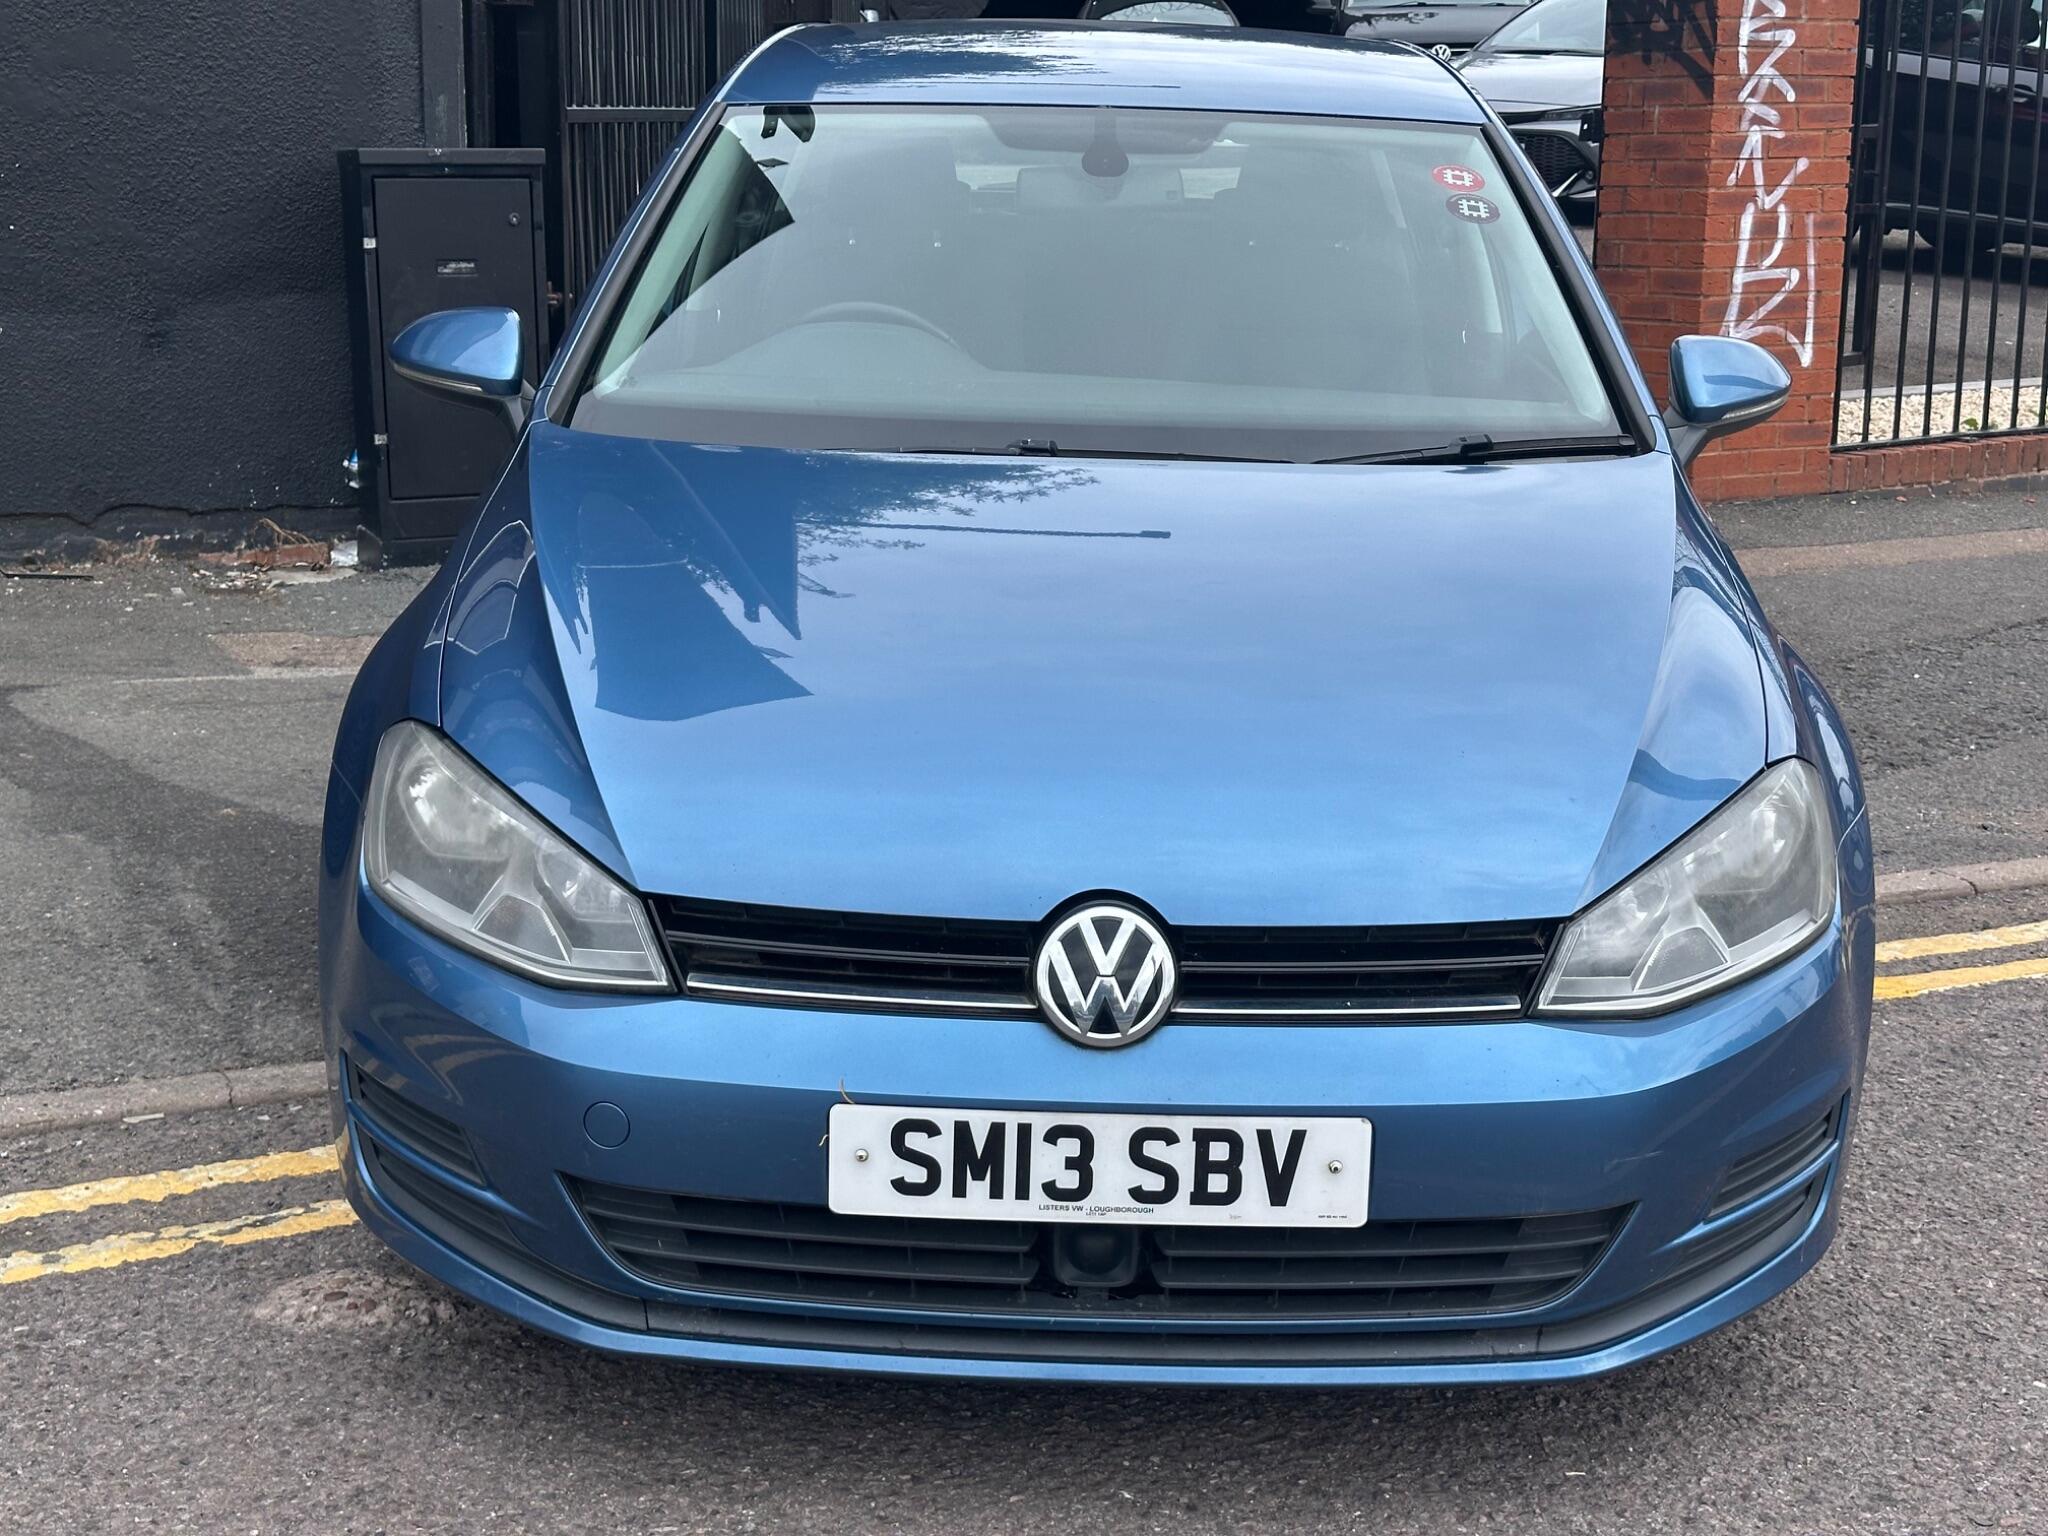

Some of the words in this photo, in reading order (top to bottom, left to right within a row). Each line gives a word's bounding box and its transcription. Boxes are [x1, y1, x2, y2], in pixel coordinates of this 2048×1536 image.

[1038, 906, 1174, 1042] VW
[890, 1118, 1095, 1203] SM13
[1127, 1126, 1308, 1207] SBV
[1038, 1204, 1070, 1212] LISTERS
[1071, 1204, 1084, 1212] VW
[1089, 1205, 1154, 1214] LOUGHBOROUGH
